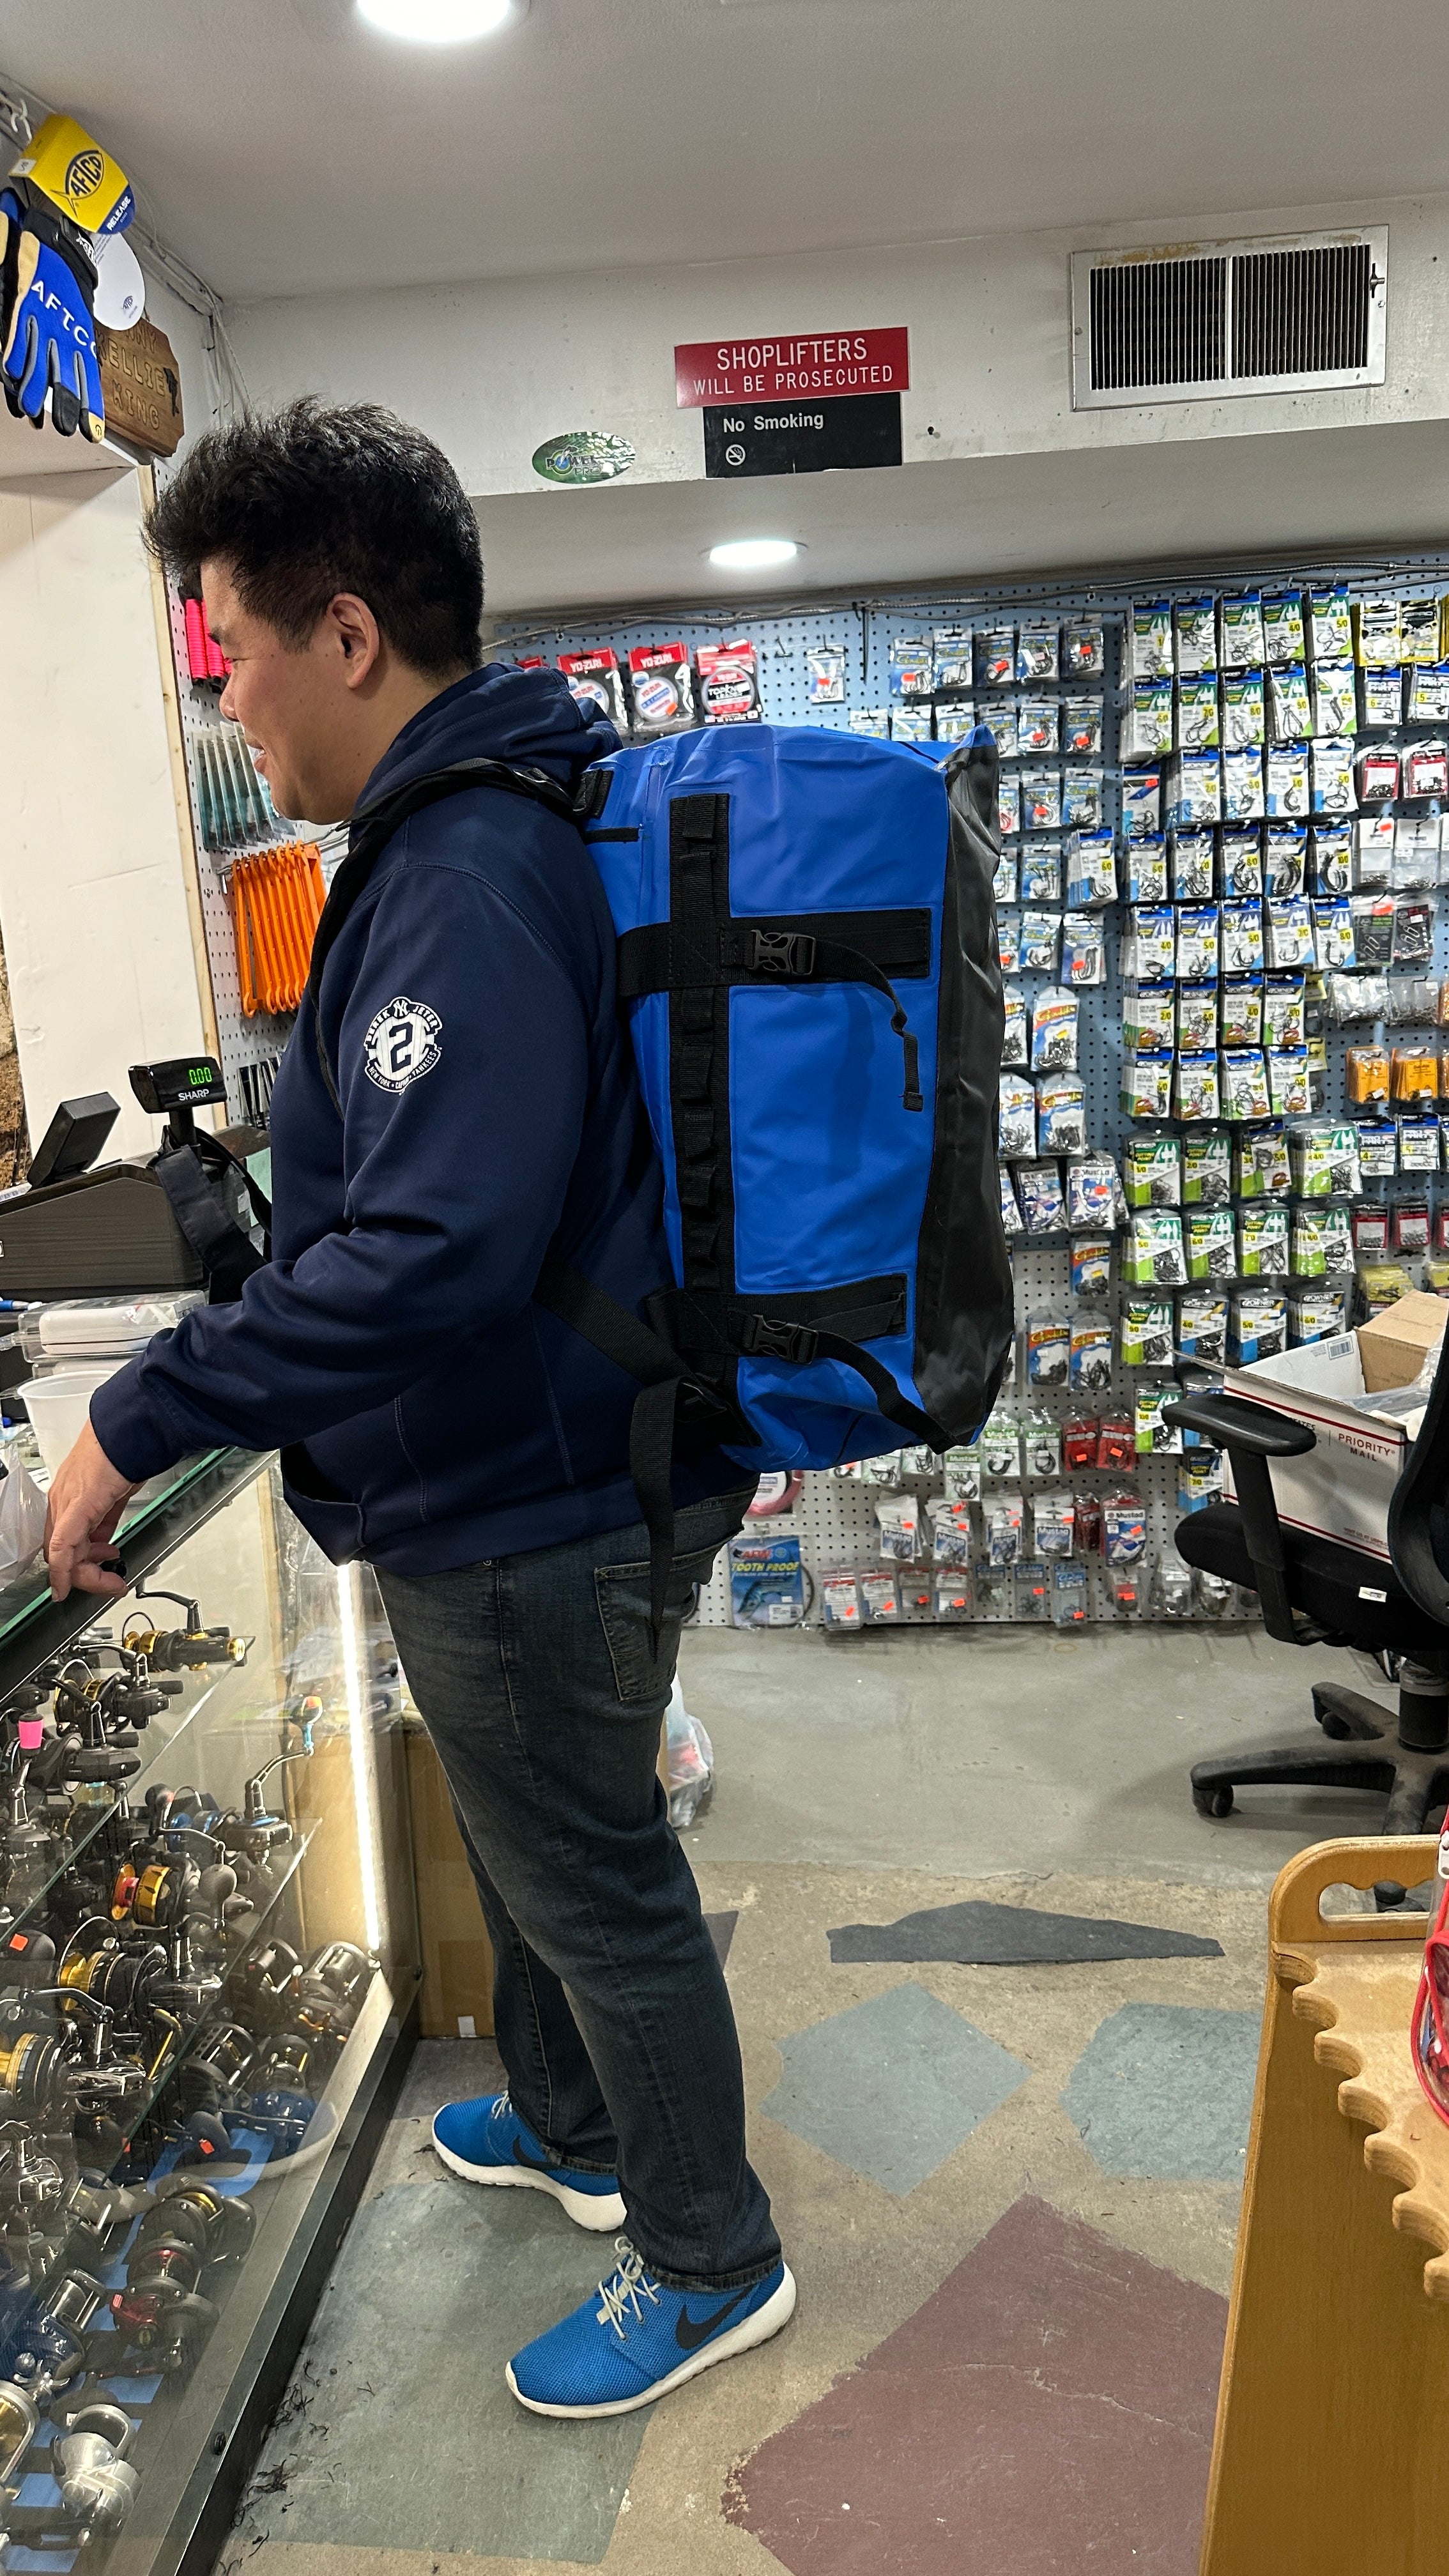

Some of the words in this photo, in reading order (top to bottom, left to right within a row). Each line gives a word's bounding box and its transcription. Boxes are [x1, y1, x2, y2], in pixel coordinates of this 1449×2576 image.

[106, 195, 131, 231] RELEASE
[96, 329, 165, 397] KELLIE
[716, 337, 868, 371] SHOPLIFTERS
[693, 378, 734, 396] WILL
[744, 374, 765, 392] BE
[775, 365, 893, 390] PROSECUTED
[111, 378, 160, 430] KING
[723, 417, 746, 433] No
[753, 412, 824, 431] Smoking
[574, 465, 602, 477] PRO
[1289, 623, 1301, 632] 4/0
[1336, 620, 1348, 628] 5/0
[569, 658, 602, 673] YO-ZURI
[640, 652, 673, 669] YO-ZURI
[1250, 707, 1261, 716] 8/0
[1340, 932, 1351, 940] 8/0
[412, 1005, 438, 1028] JETER
[1160, 1011, 1171, 1020] 2/0
[388, 1022, 413, 1073] 2
[411, 1050, 437, 1077] YANKEES
[188, 1066, 213, 1085] 0.00
[178, 1088, 210, 1101] SHARP
[1338, 1432, 1391, 1456] PRIORITY
[1350, 1447, 1377, 1462] MAIL
[731, 1563, 765, 1572] TOOTH
[766, 1561, 800, 1571] PROOF
